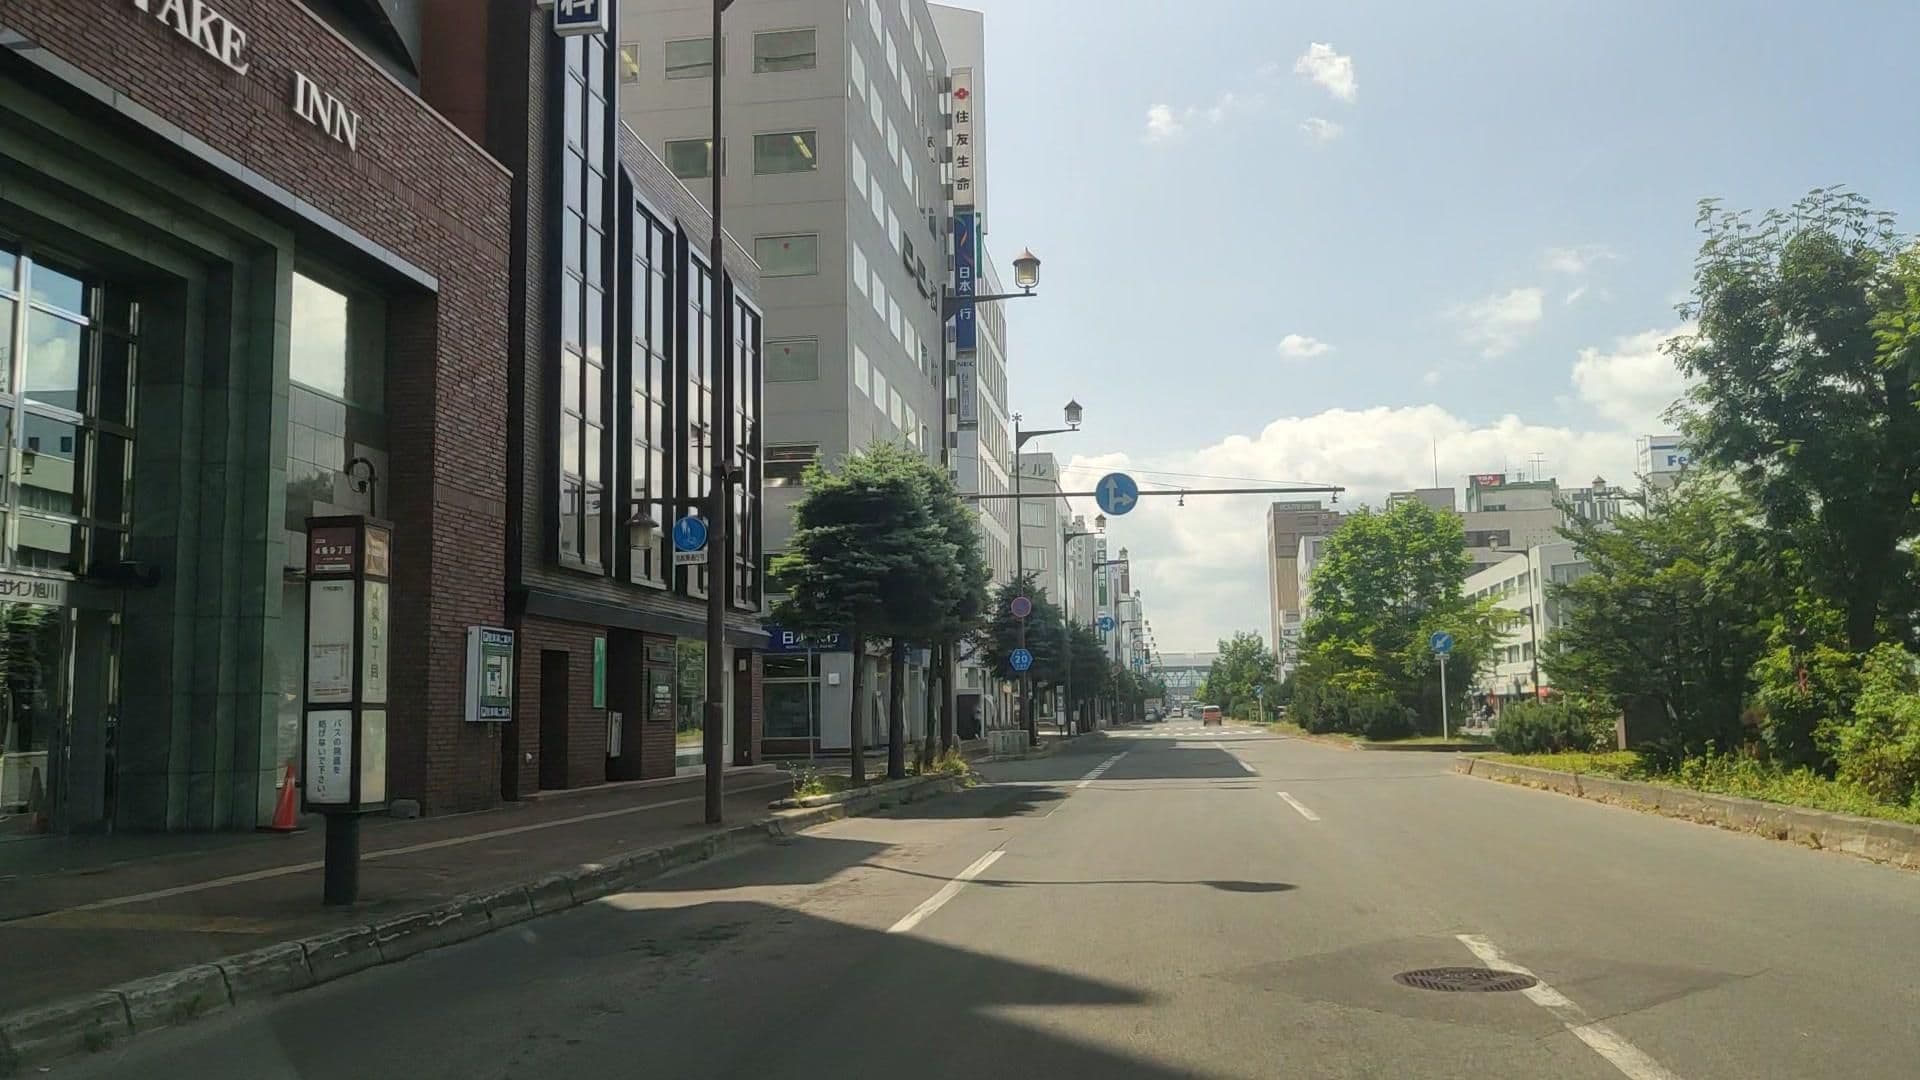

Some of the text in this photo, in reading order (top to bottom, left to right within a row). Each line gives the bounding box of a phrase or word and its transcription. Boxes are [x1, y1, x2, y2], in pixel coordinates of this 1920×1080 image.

[133, 0, 362, 152] AKE INN
[955, 110, 969, 191] 住友生命
[959, 266, 971, 320] 日本行
[1014, 655, 1029, 664] 20
